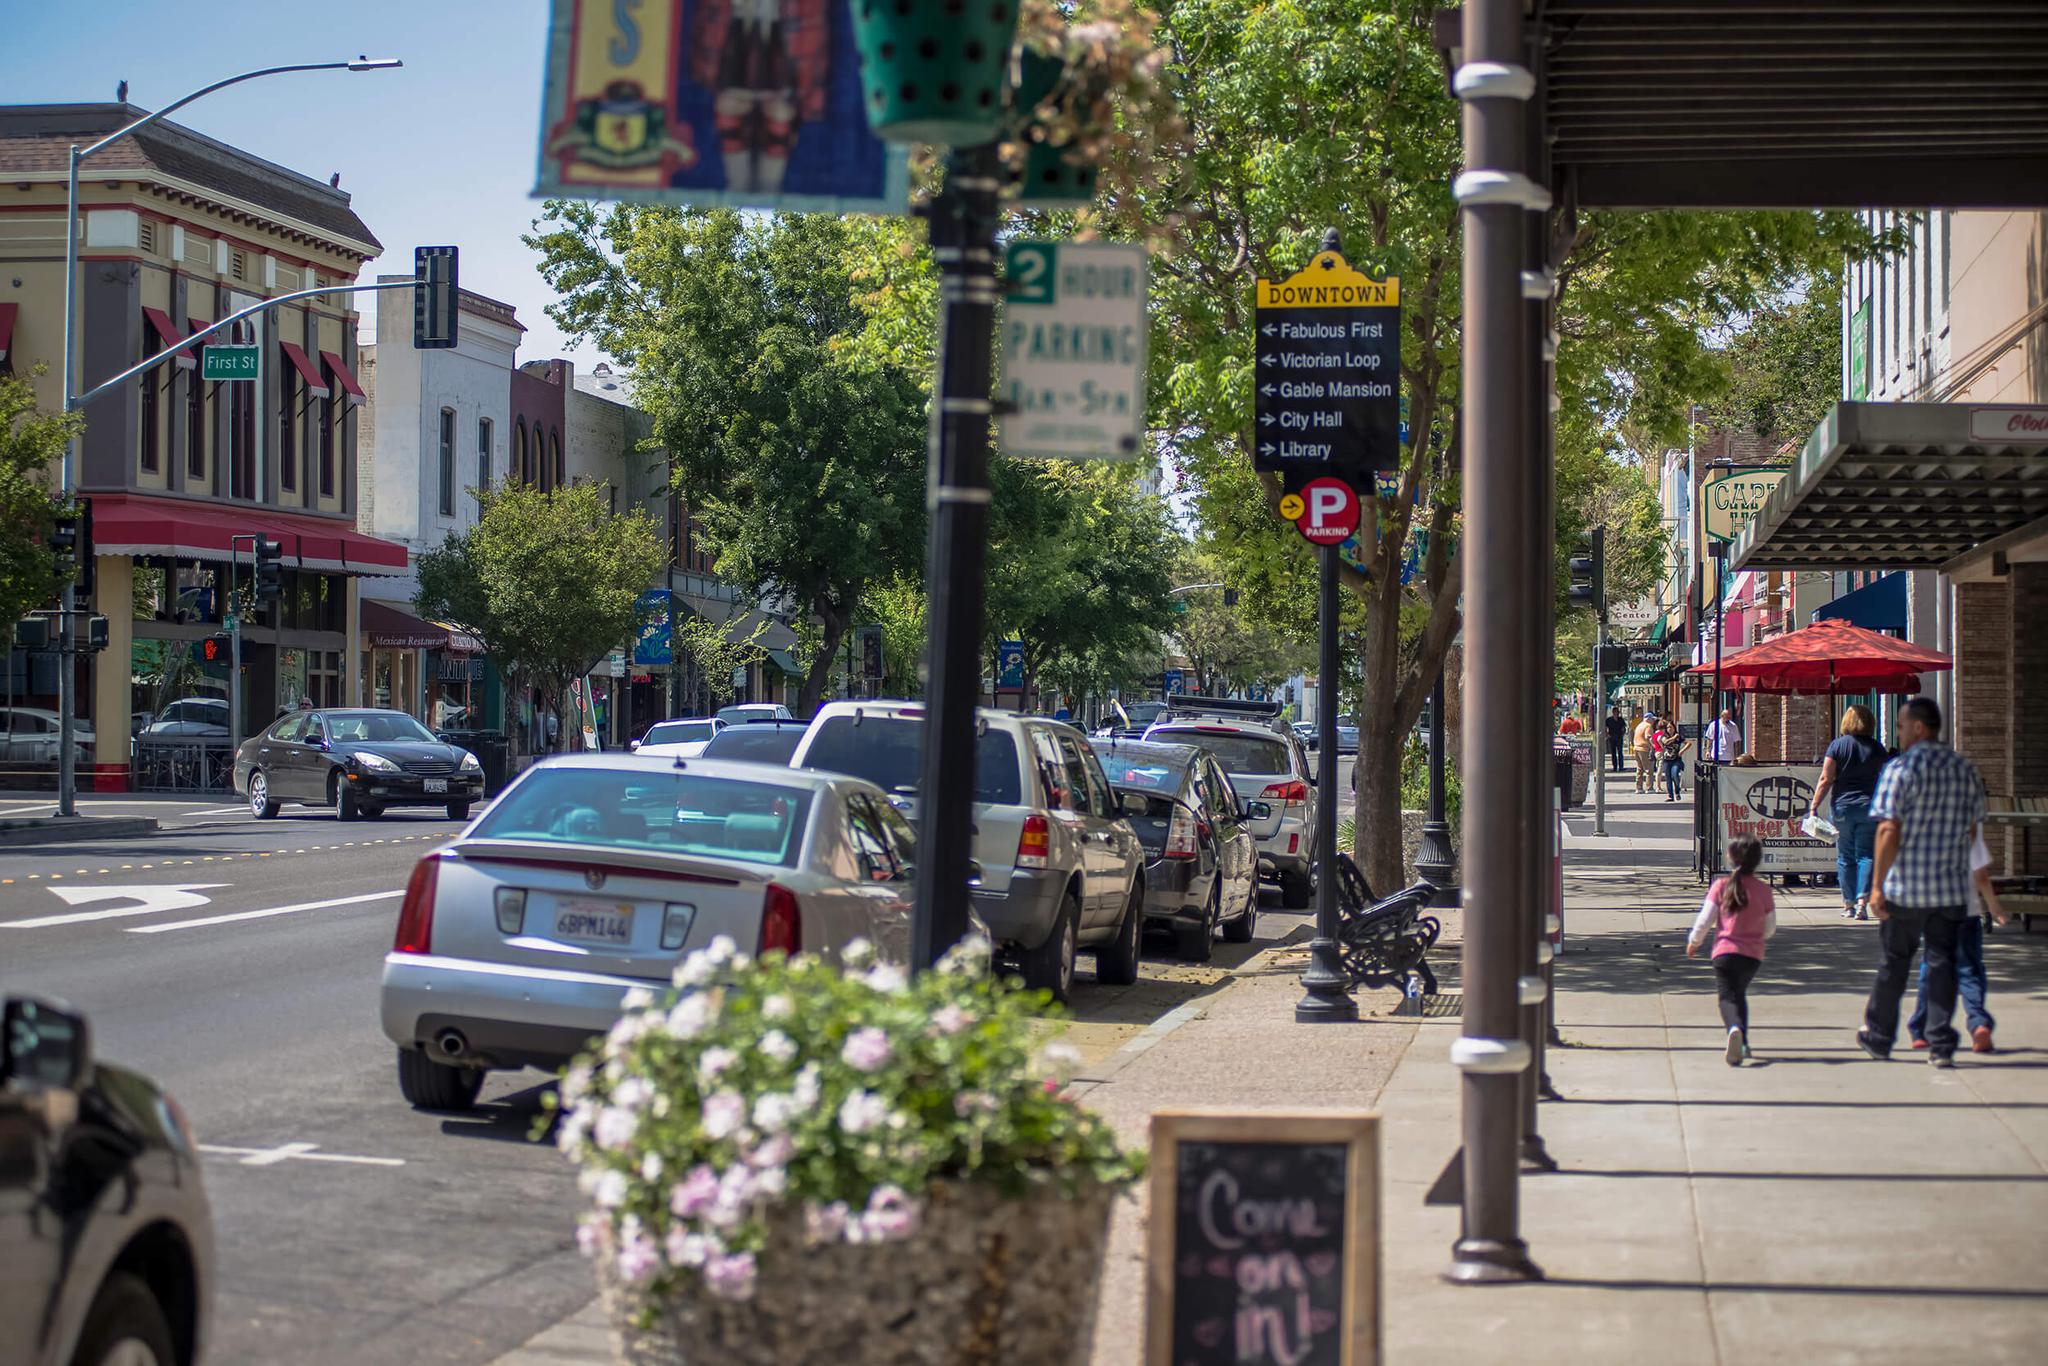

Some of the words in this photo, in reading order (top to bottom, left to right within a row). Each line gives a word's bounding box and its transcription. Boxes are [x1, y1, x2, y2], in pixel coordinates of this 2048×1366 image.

[1269, 286, 1387, 304] DOWNTOWN
[1280, 323, 1346, 339] Fabulous
[1351, 322, 1383, 338] First
[1008, 320, 1137, 365] PARKING
[207, 355, 237, 369] First
[242, 355, 255, 369] St
[1280, 353, 1342, 368] Victorian
[1346, 352, 1381, 371] Loop
[1280, 382, 1325, 398] Gable
[1329, 381, 1392, 397] Mansion
[1280, 411, 1309, 431] City
[1313, 411, 1343, 427] Hall
[1280, 441, 1332, 461] Library
[1311, 487, 1347, 528] P
[1306, 527, 1349, 537] PARKING
[375, 635, 406, 646] Mexican
[408, 636, 448, 647] Restaurant
[1722, 803, 1750, 820] The
[1199, 1167, 1328, 1249] Come
[1236, 1252, 1308, 1295] on
